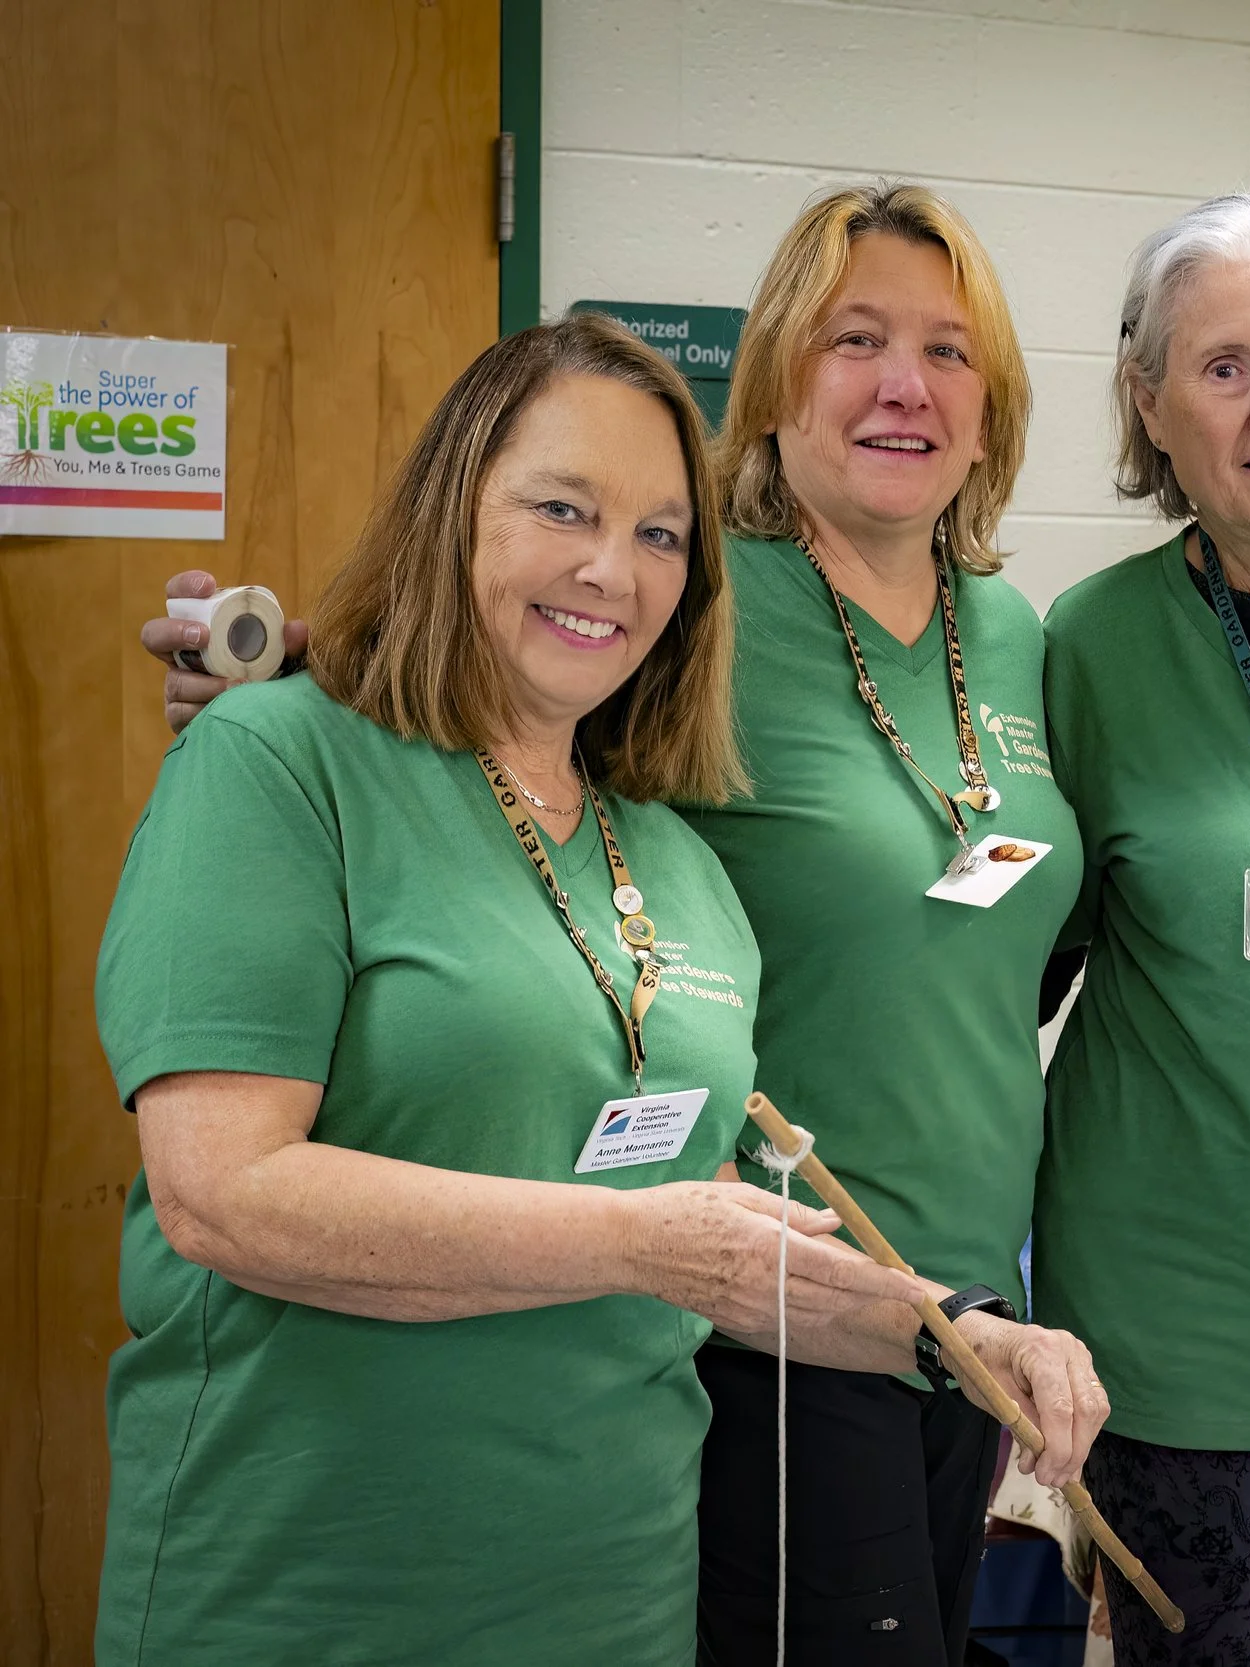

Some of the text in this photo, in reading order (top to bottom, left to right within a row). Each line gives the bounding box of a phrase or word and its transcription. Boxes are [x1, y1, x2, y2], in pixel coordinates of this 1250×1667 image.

[686, 344, 732, 369] Only
[99, 370, 156, 391] Super
[59, 380, 199, 411] the power of
[53, 458, 221, 478] You, Me & Trees Game
[1005, 726, 1035, 740] Master
[1000, 759, 1032, 774] Tree
[679, 980, 744, 1009] Stewards
[636, 1110, 682, 1123] Cooperative
[641, 1103, 670, 1114] Virginia
[631, 1121, 669, 1132] Extension
[595, 1139, 674, 1158] Anne Mannarino
